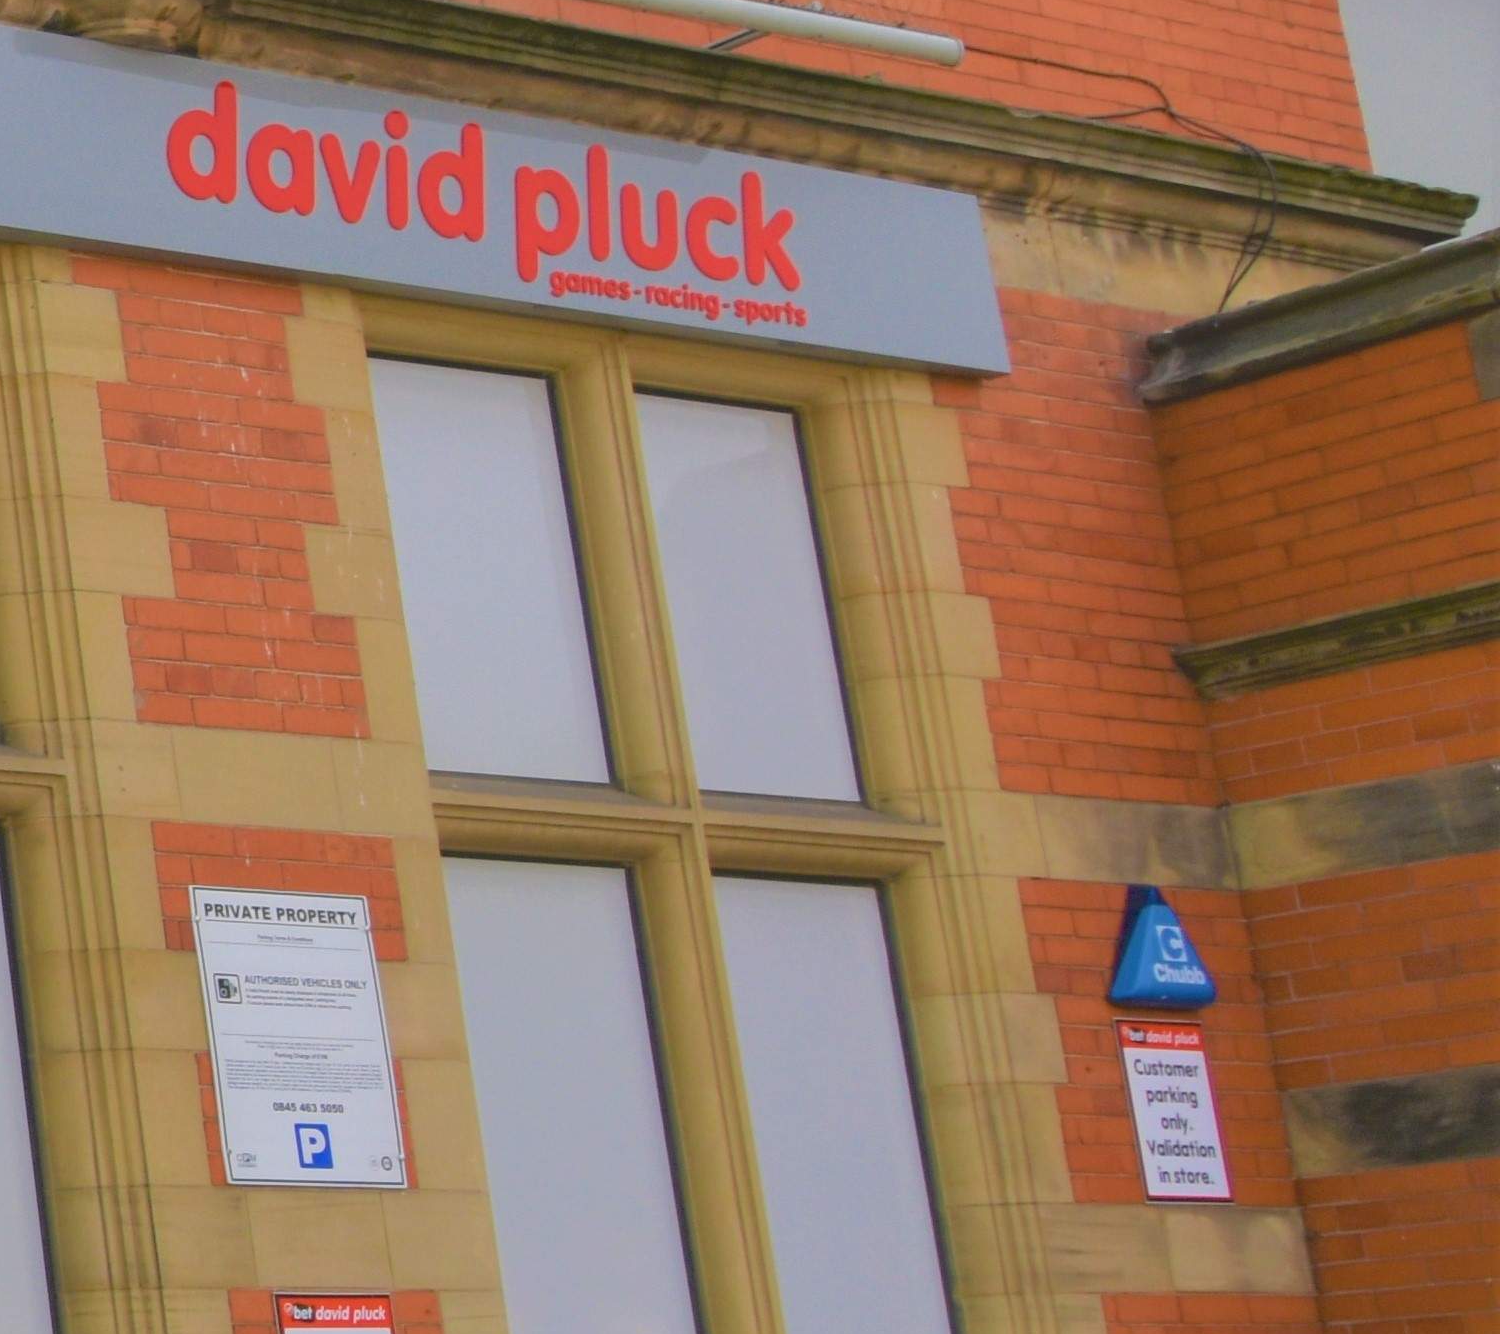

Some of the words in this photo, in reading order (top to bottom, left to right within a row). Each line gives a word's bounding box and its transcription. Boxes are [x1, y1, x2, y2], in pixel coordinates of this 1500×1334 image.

[165, 80, 484, 242] david
[515, 143, 801, 292] pluck
[549, 270, 631, 303] games
[645, 283, 720, 321] racing
[734, 295, 807, 329] sports
[203, 902, 271, 921] PRIVATE
[275, 907, 357, 926] PROPERTY
[244, 975, 299, 987] AUTHORISED
[301, 978, 342, 989] VEHICLES
[344, 980, 367, 990] ONLY
[1153, 962, 1206, 985] Chubb
[1145, 1030, 1172, 1044] david
[1174, 1031, 1199, 1047] pluck
[1133, 1058, 1198, 1078] Customer
[272, 1101, 297, 1112] 0845
[299, 1103, 318, 1113] 463
[320, 1104, 344, 1114] 5050
[1146, 1085, 1199, 1109] parking
[1160, 1114, 1194, 1135] only.
[298, 1127, 327, 1165] P
[1146, 1138, 1216, 1159] Validation
[1157, 1165, 1171, 1184] in
[1173, 1166, 1215, 1186] store.
[293, 1306, 313, 1321] bet
[315, 1306, 350, 1321] david
[353, 1306, 386, 1324] pluck
